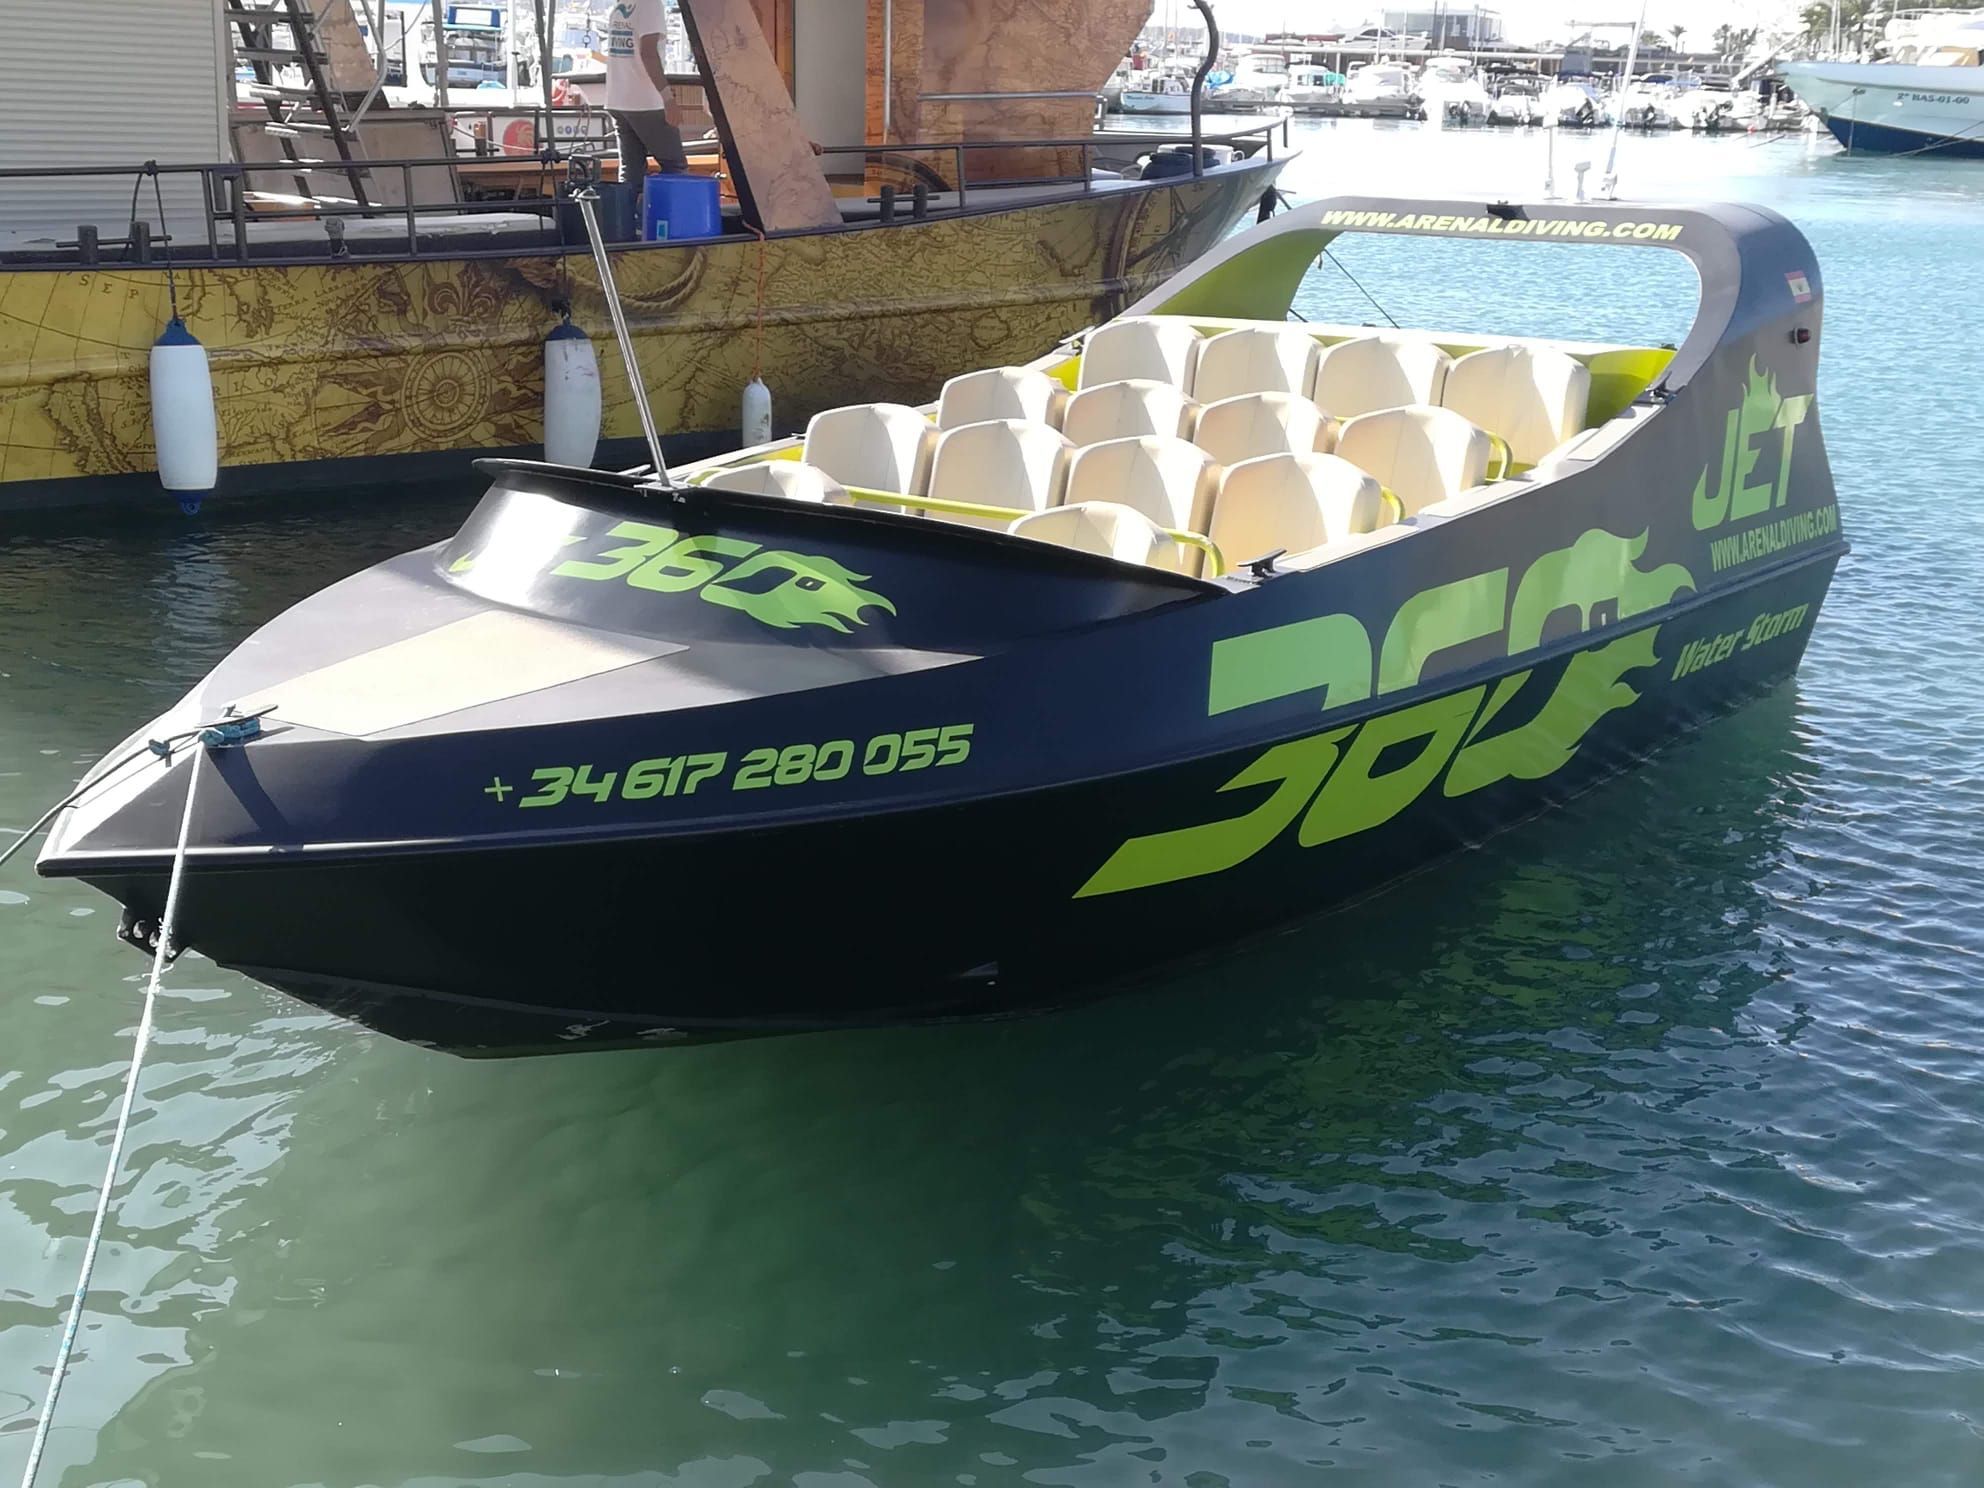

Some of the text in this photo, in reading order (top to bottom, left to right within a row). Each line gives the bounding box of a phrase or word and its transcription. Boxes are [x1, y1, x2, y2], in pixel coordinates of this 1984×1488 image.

[1320, 210, 1683, 241] WWW.ARENALDIVING.COM
[1692, 352, 1815, 531] JET
[1710, 503, 1838, 573] WWW.ARENALDIVING.COM
[550, 521, 897, 634] 360
[1671, 603, 1810, 682] Water Storm
[732, 740, 855, 791] 280
[864, 723, 975, 777] 055
